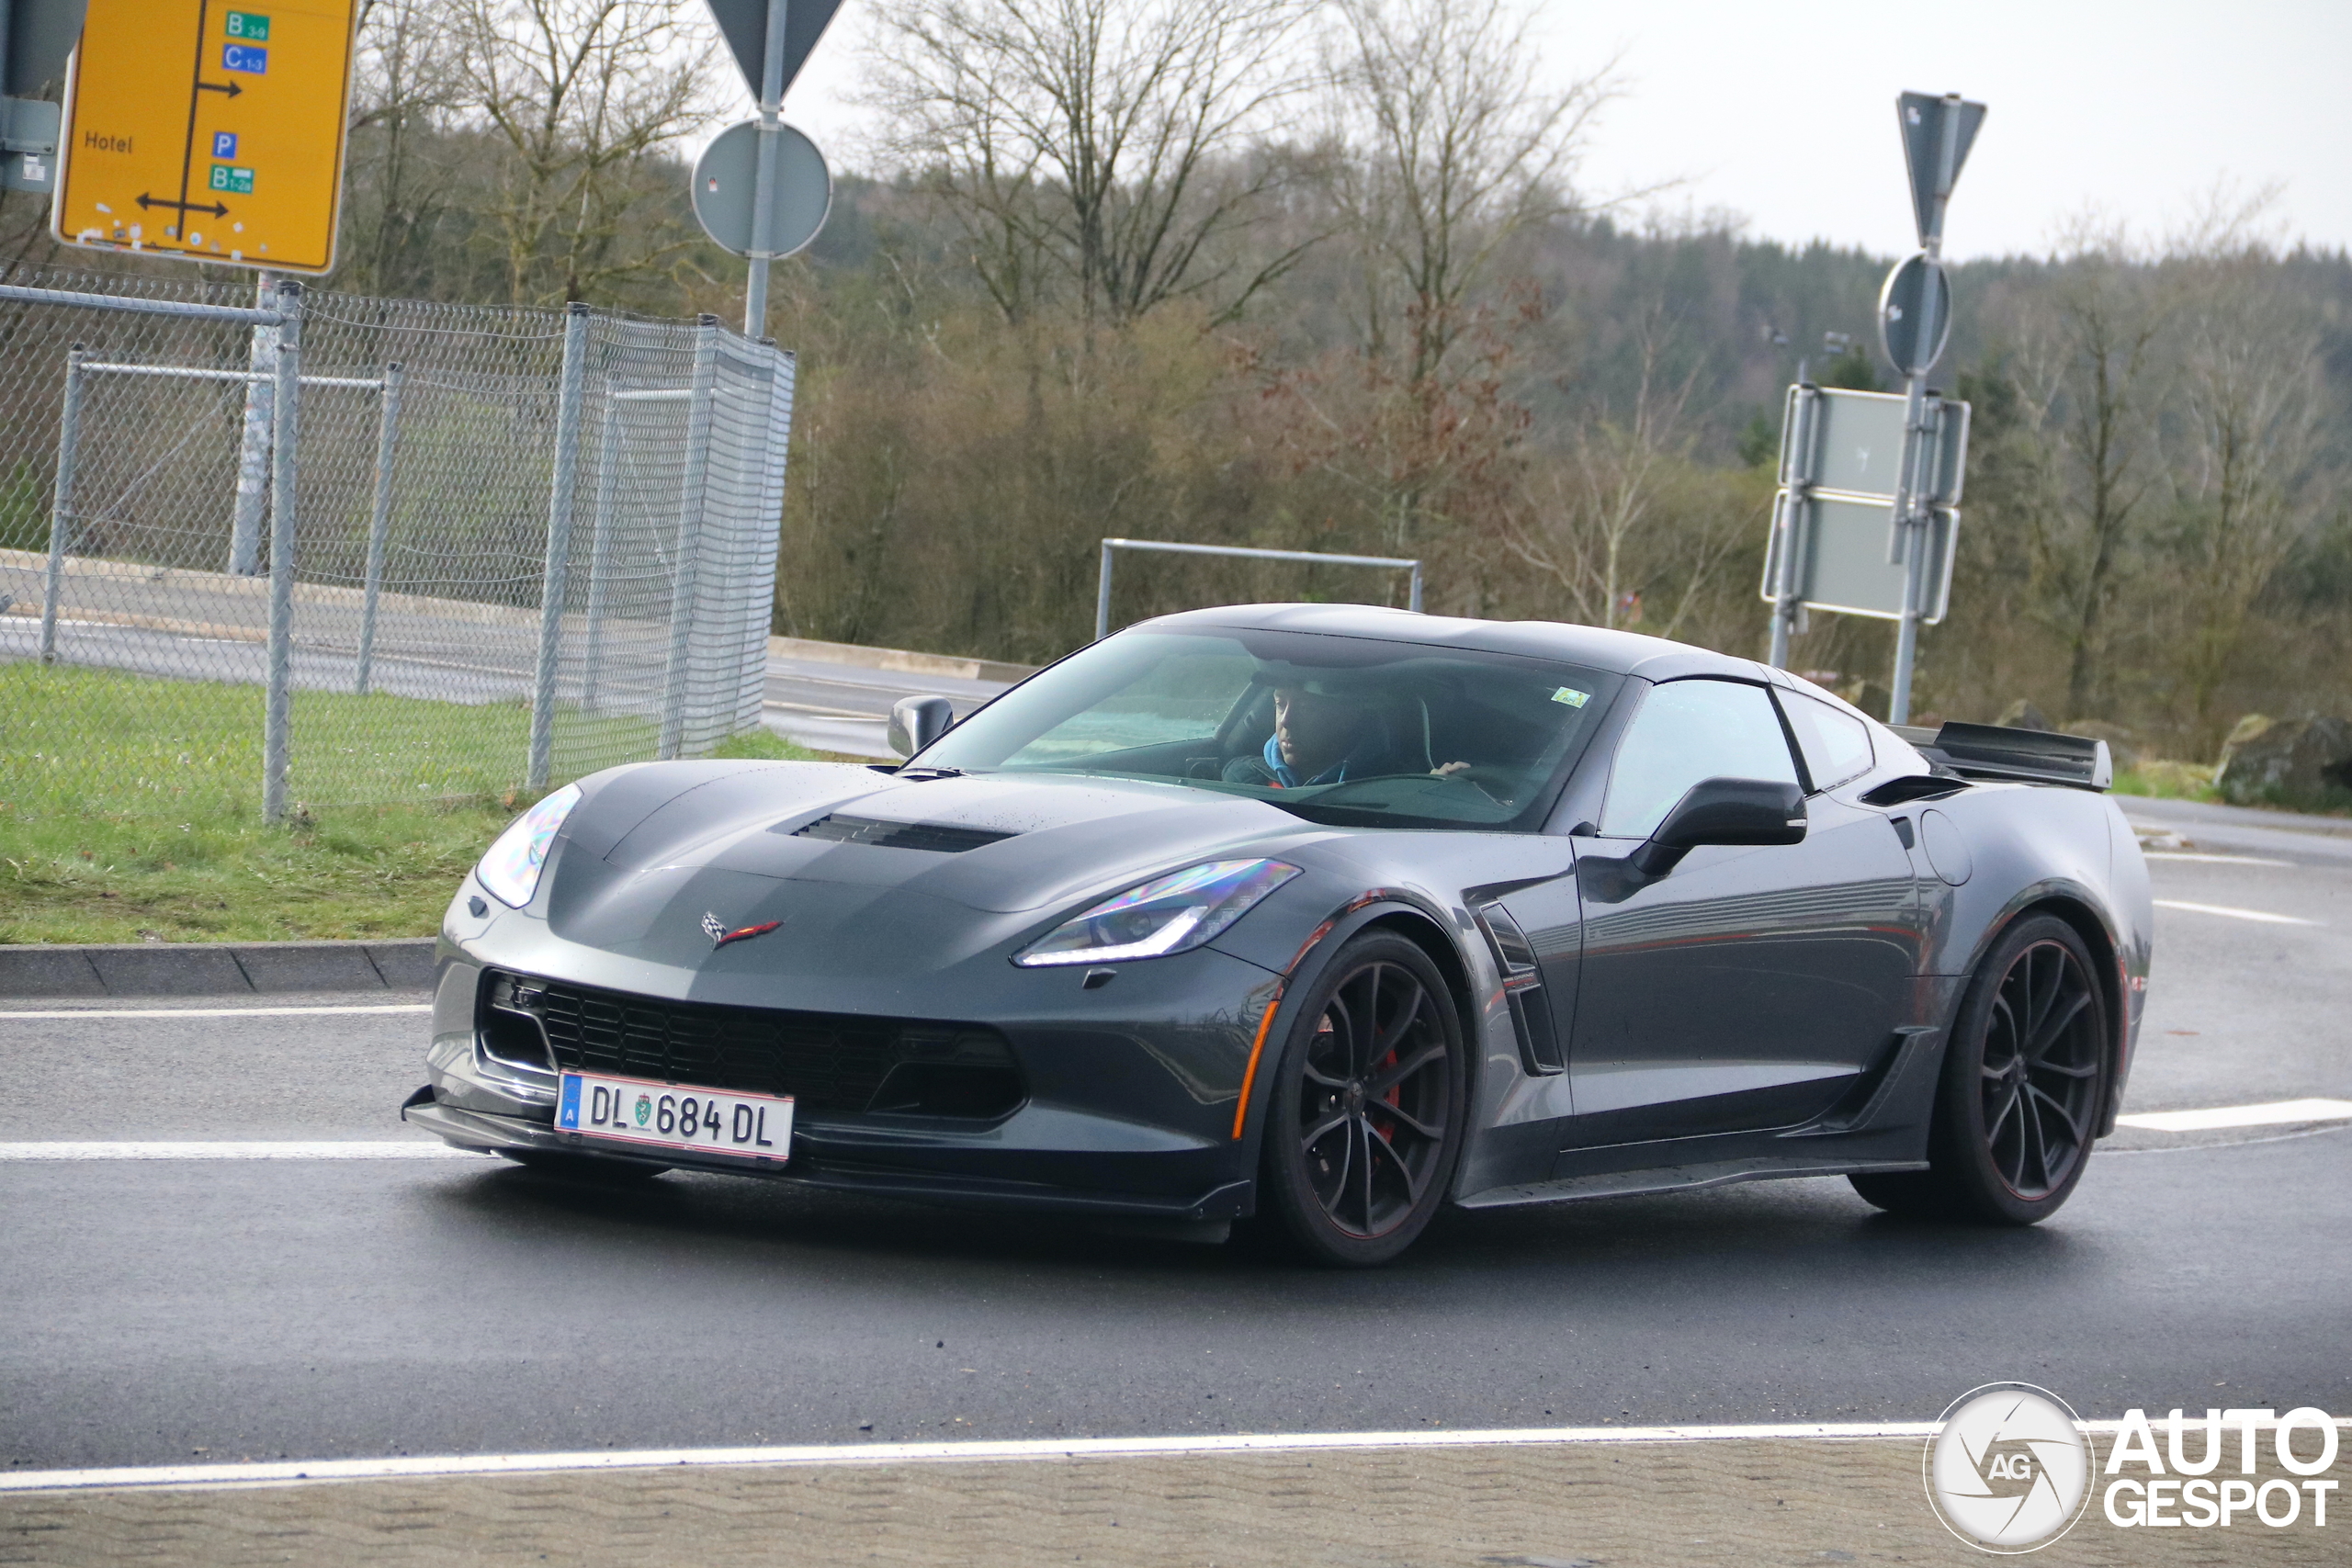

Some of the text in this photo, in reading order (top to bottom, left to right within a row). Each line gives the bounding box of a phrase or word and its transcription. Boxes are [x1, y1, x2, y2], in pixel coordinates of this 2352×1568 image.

[228, 13, 243, 35] B
[225, 46, 241, 67] C
[85, 130, 133, 154] Hotel
[217, 135, 232, 154] P
[213, 168, 228, 187] B
[565, 1109, 574, 1122] A
[592, 1085, 773, 1146] DL 684 DL
